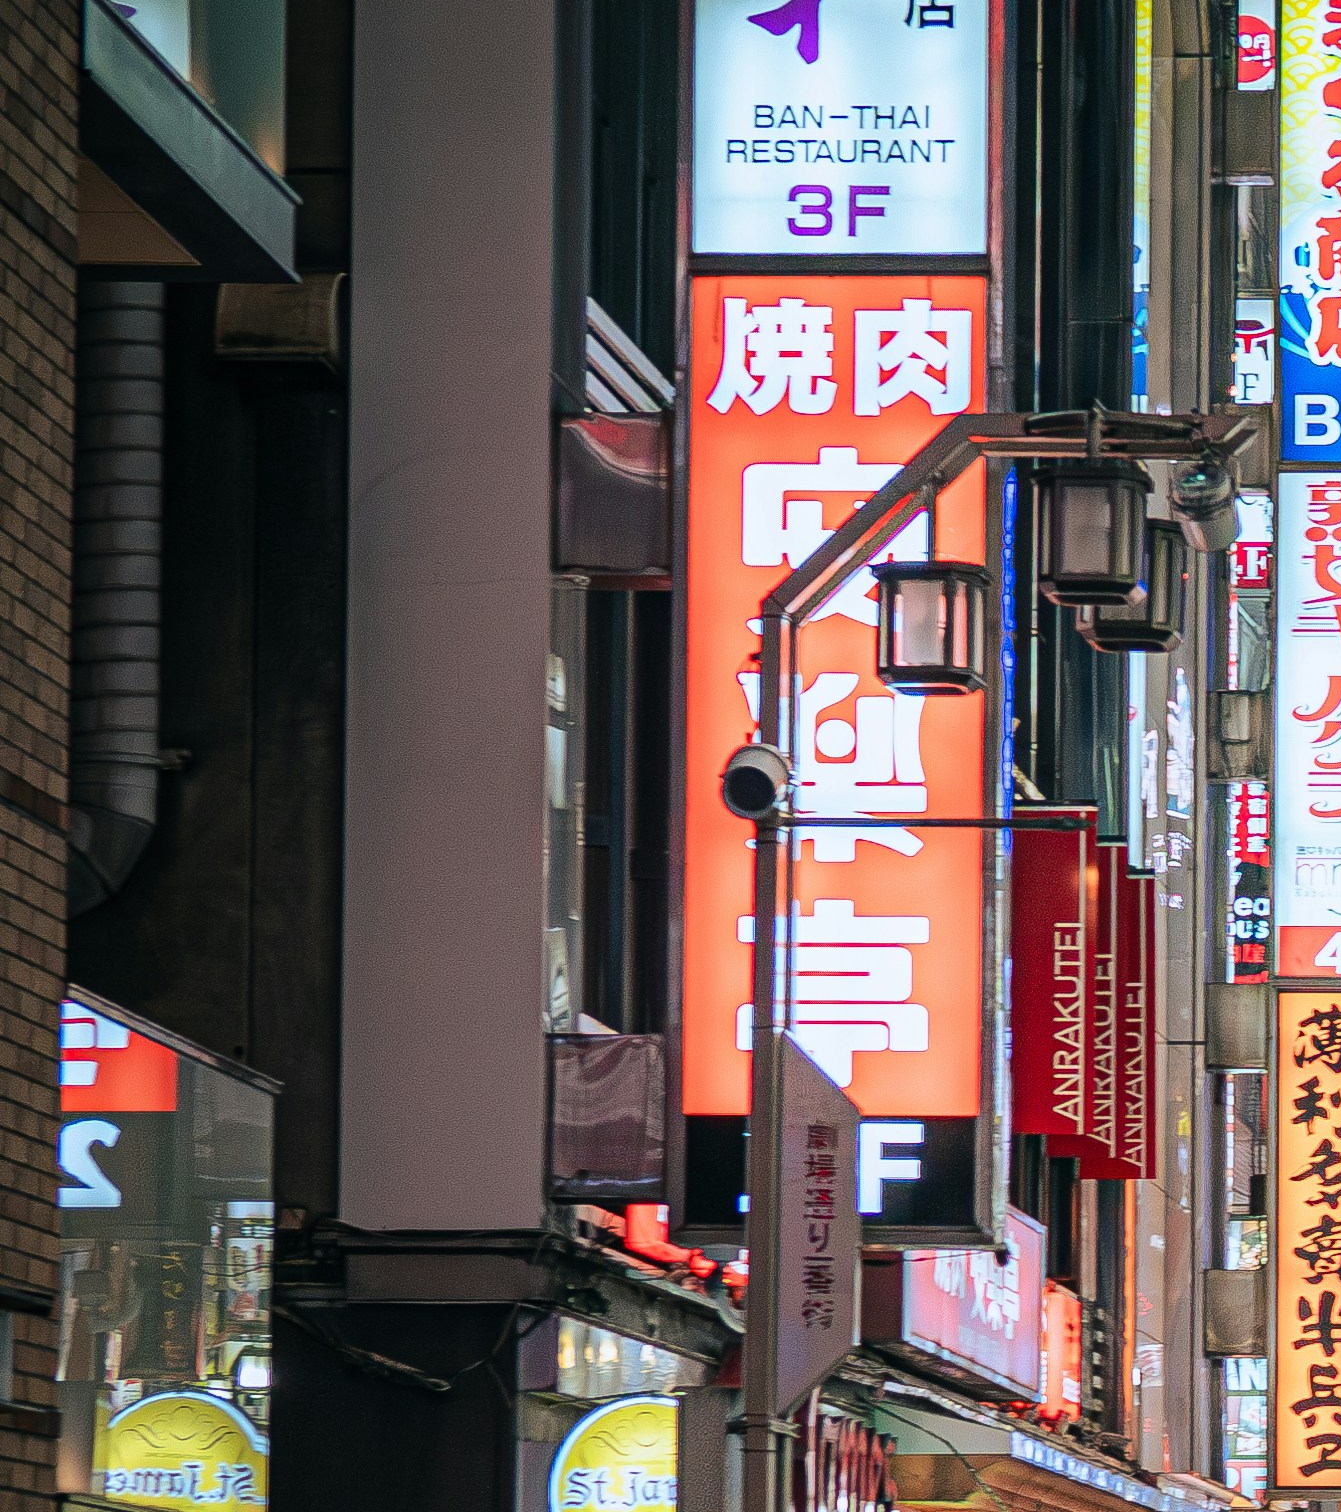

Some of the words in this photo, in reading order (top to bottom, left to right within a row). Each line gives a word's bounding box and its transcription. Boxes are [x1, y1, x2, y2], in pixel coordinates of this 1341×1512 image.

[753, 104, 931, 130] BAN-THAI
[726, 137, 955, 164] RESTAURANT
[786, 184, 893, 238] 3F
[707, 297, 972, 417] 焼肉
[1051, 923, 1083, 1123] ANRAKUTEI
